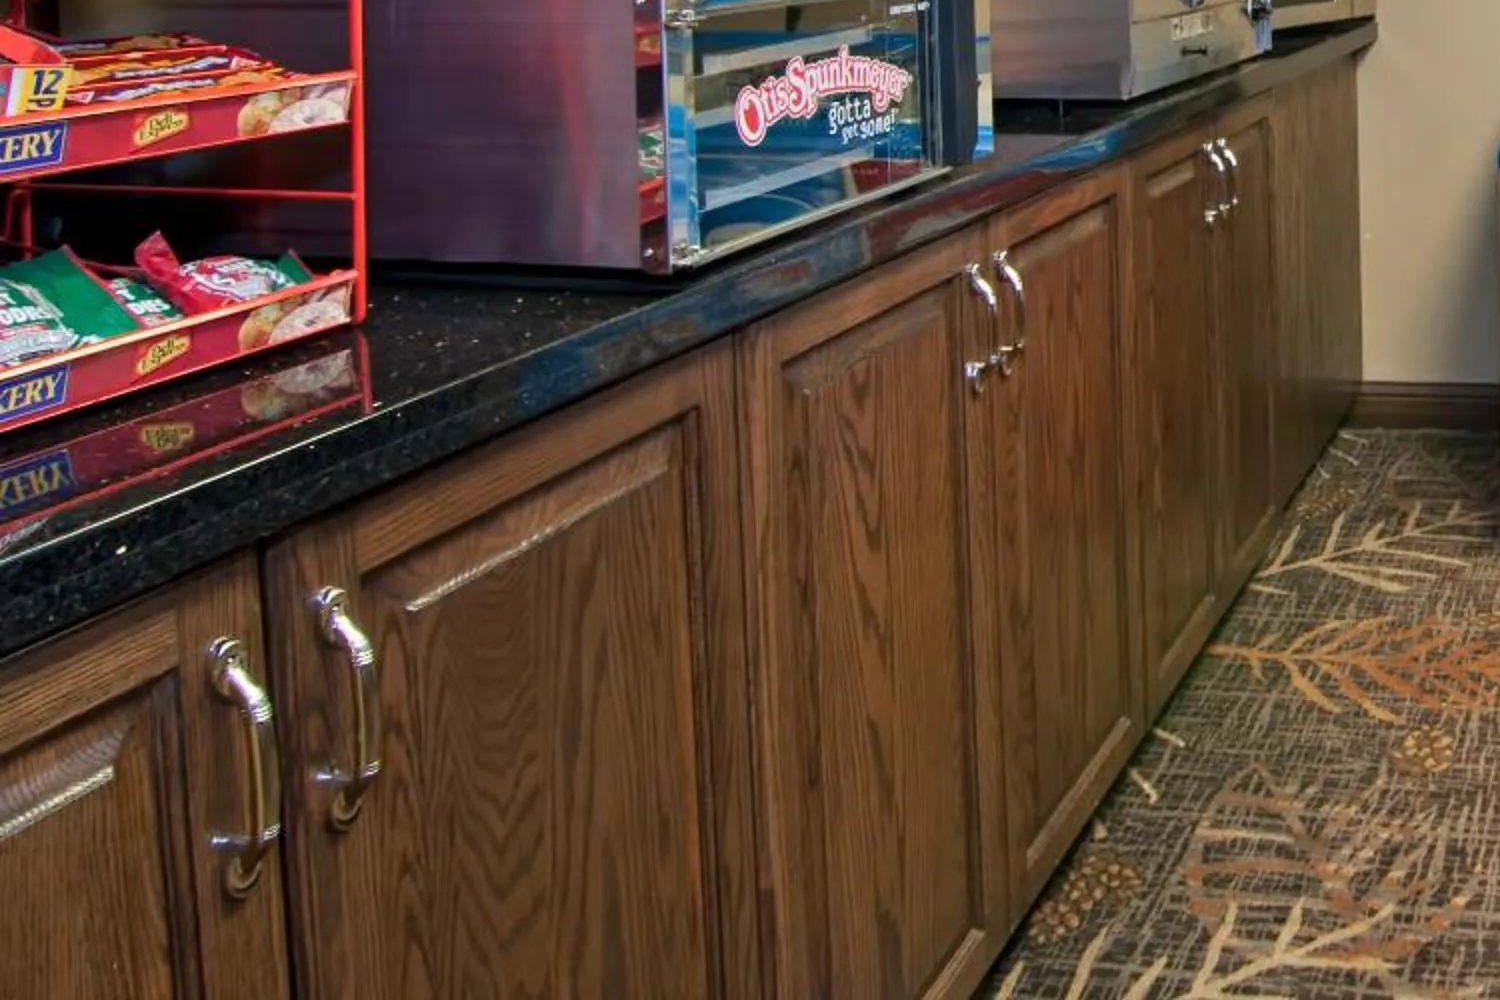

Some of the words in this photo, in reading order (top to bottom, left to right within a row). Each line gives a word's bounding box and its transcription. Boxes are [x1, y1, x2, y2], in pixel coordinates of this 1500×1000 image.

[33, 69, 64, 95] 12
[786, 44, 910, 119] Spunkmeyer
[828, 98, 871, 135] gotta
